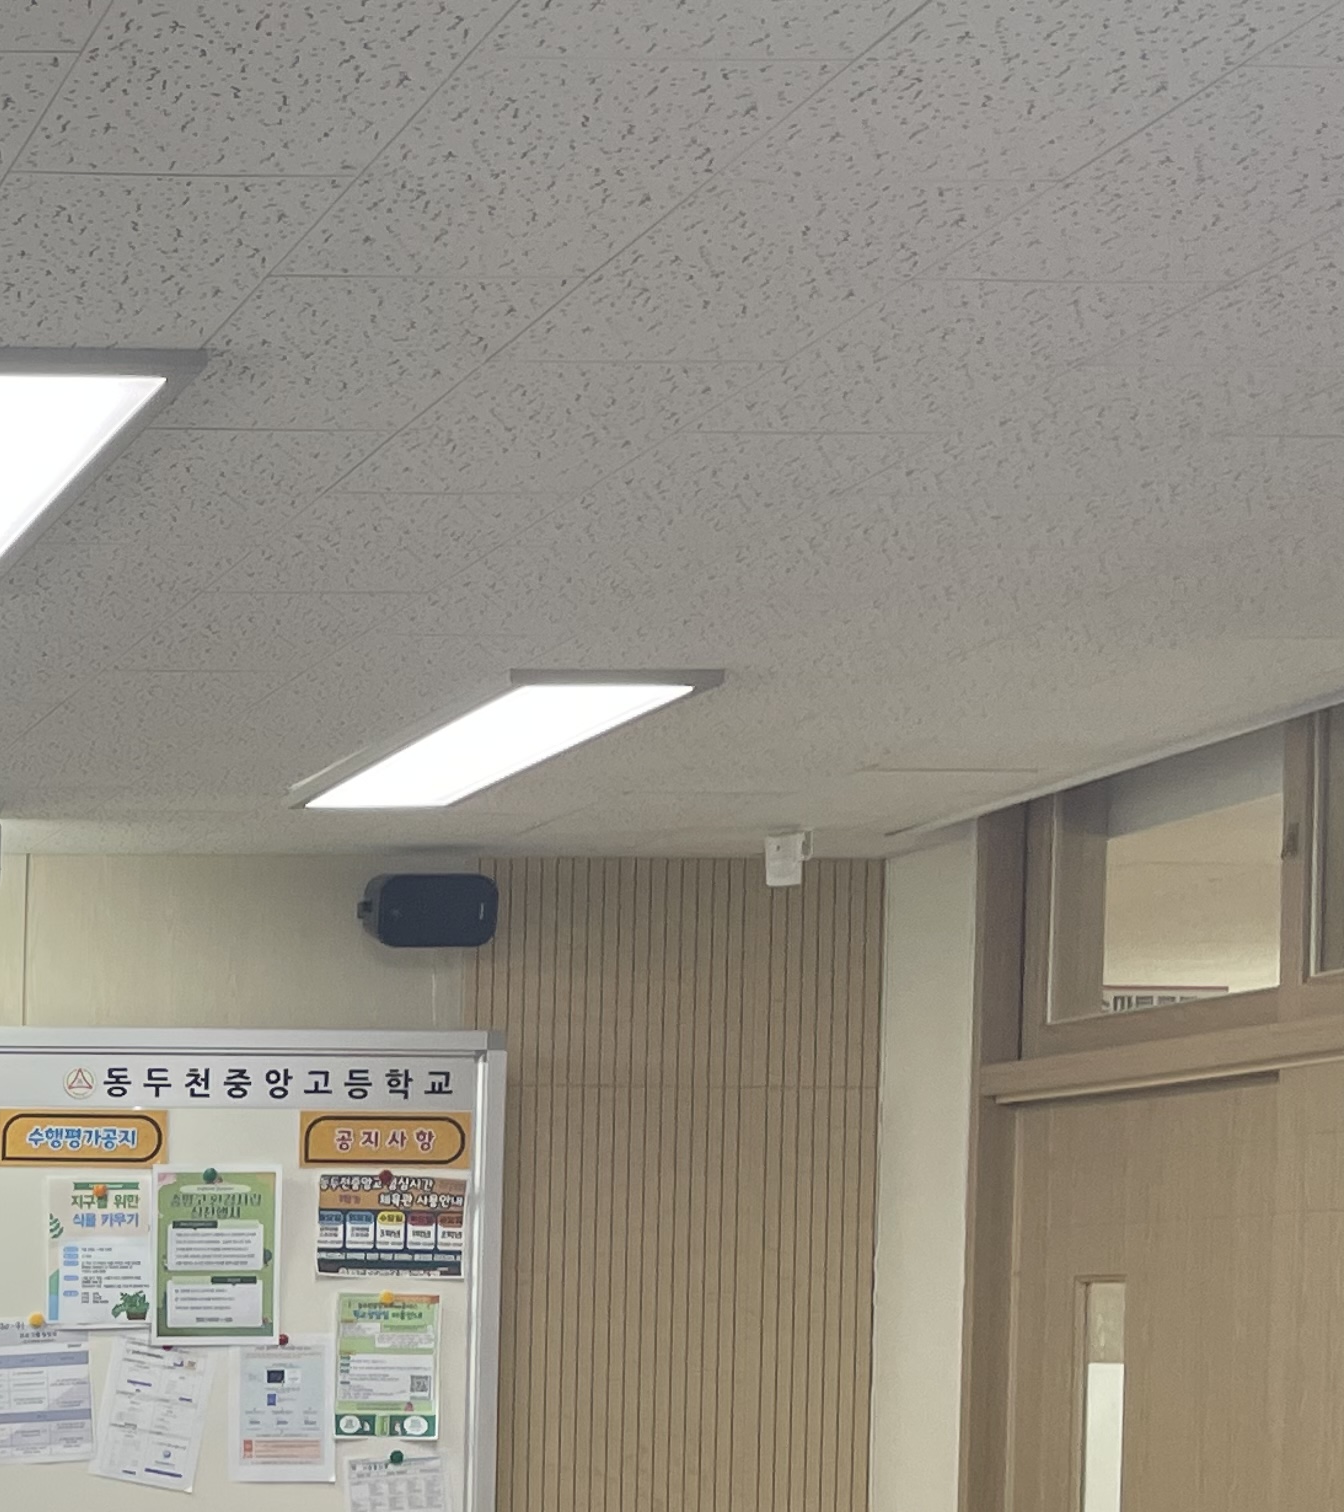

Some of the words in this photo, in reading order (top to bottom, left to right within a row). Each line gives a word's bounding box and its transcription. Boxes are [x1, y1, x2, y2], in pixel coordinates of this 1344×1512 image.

[103, 1067, 454, 1100] 동두천중앙고등학교
[27, 1127, 136, 1149] 수행평가공지
[334, 1129, 436, 1151] 공지사항
[113, 1194, 139, 1209] 위한
[101, 1212, 139, 1228] 키우기
